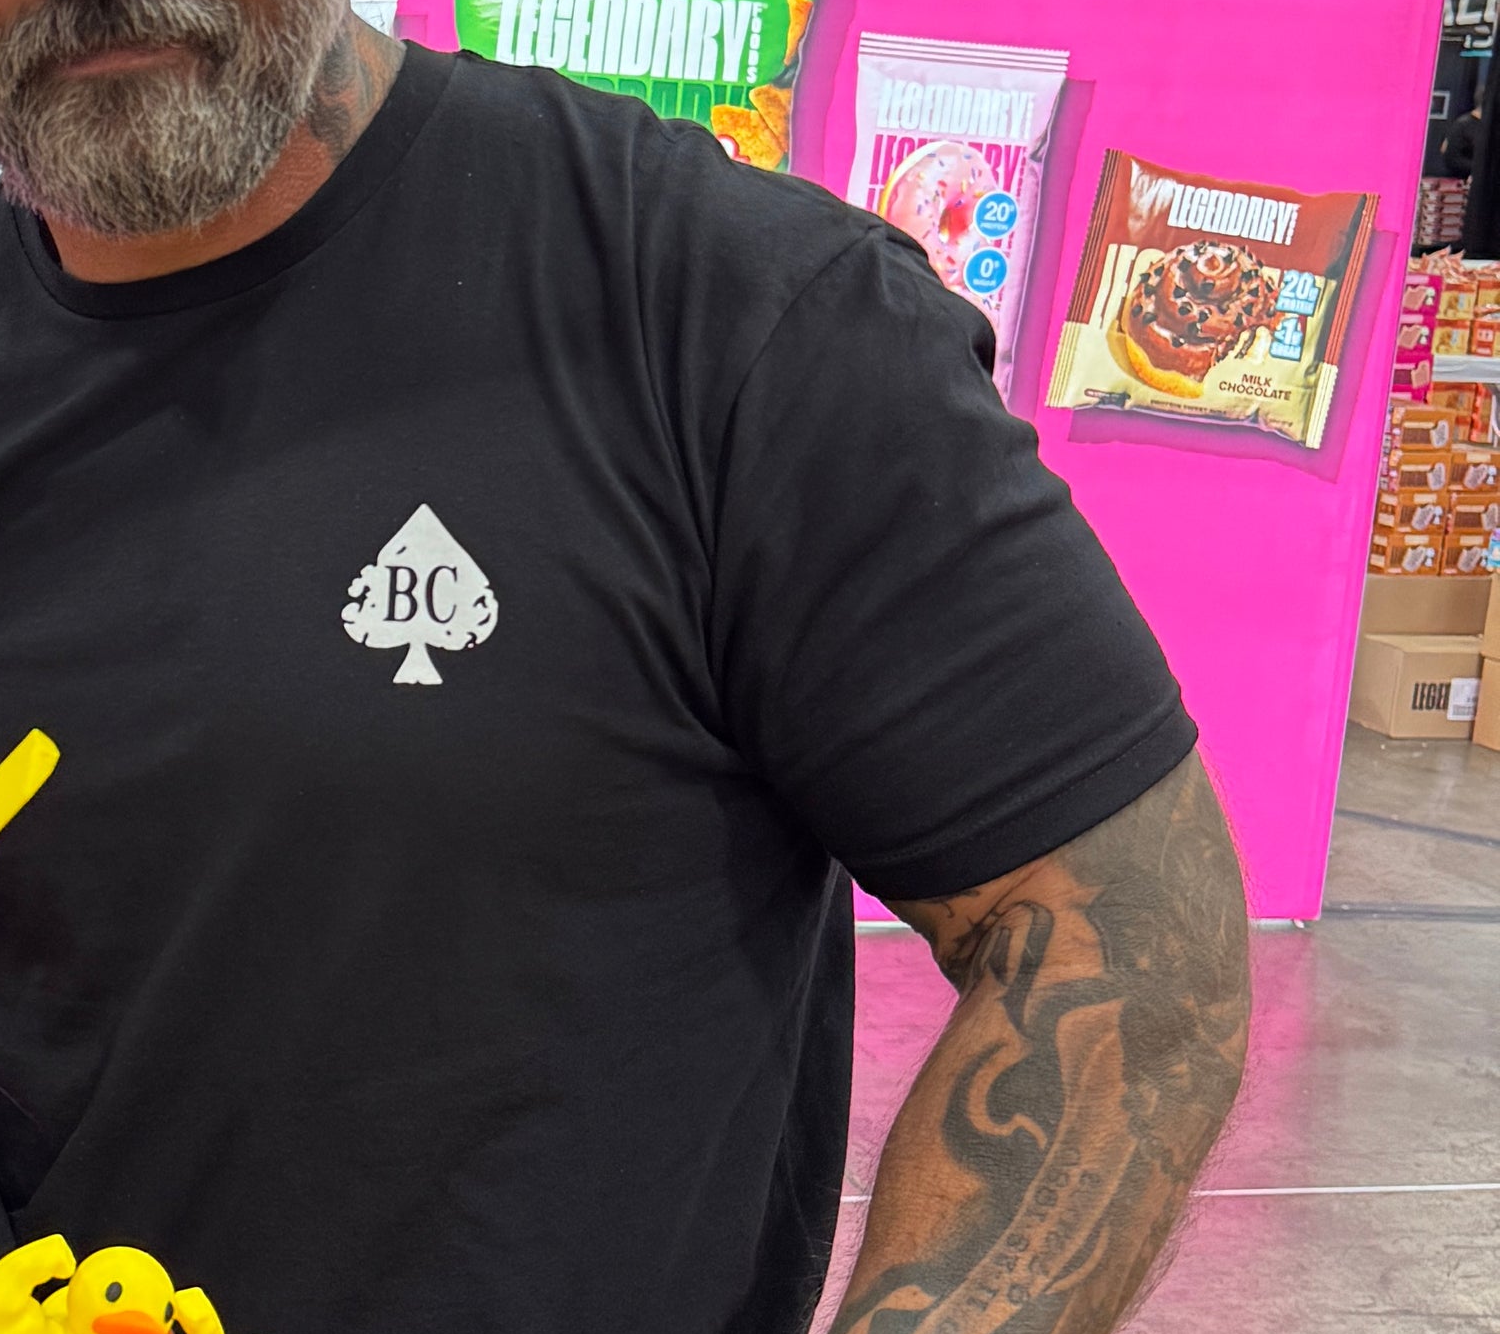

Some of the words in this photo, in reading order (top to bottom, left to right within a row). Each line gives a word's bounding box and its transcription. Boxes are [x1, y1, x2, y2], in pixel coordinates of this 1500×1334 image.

[745, 1, 763, 85] FOODS
[876, 77, 1030, 141] LEGENDARY
[1167, 183, 1295, 245] LEGENDARY
[1218, 380, 1292, 401] CHOCOLATE
[1241, 373, 1273, 388] MILK
[383, 565, 458, 624] BC
